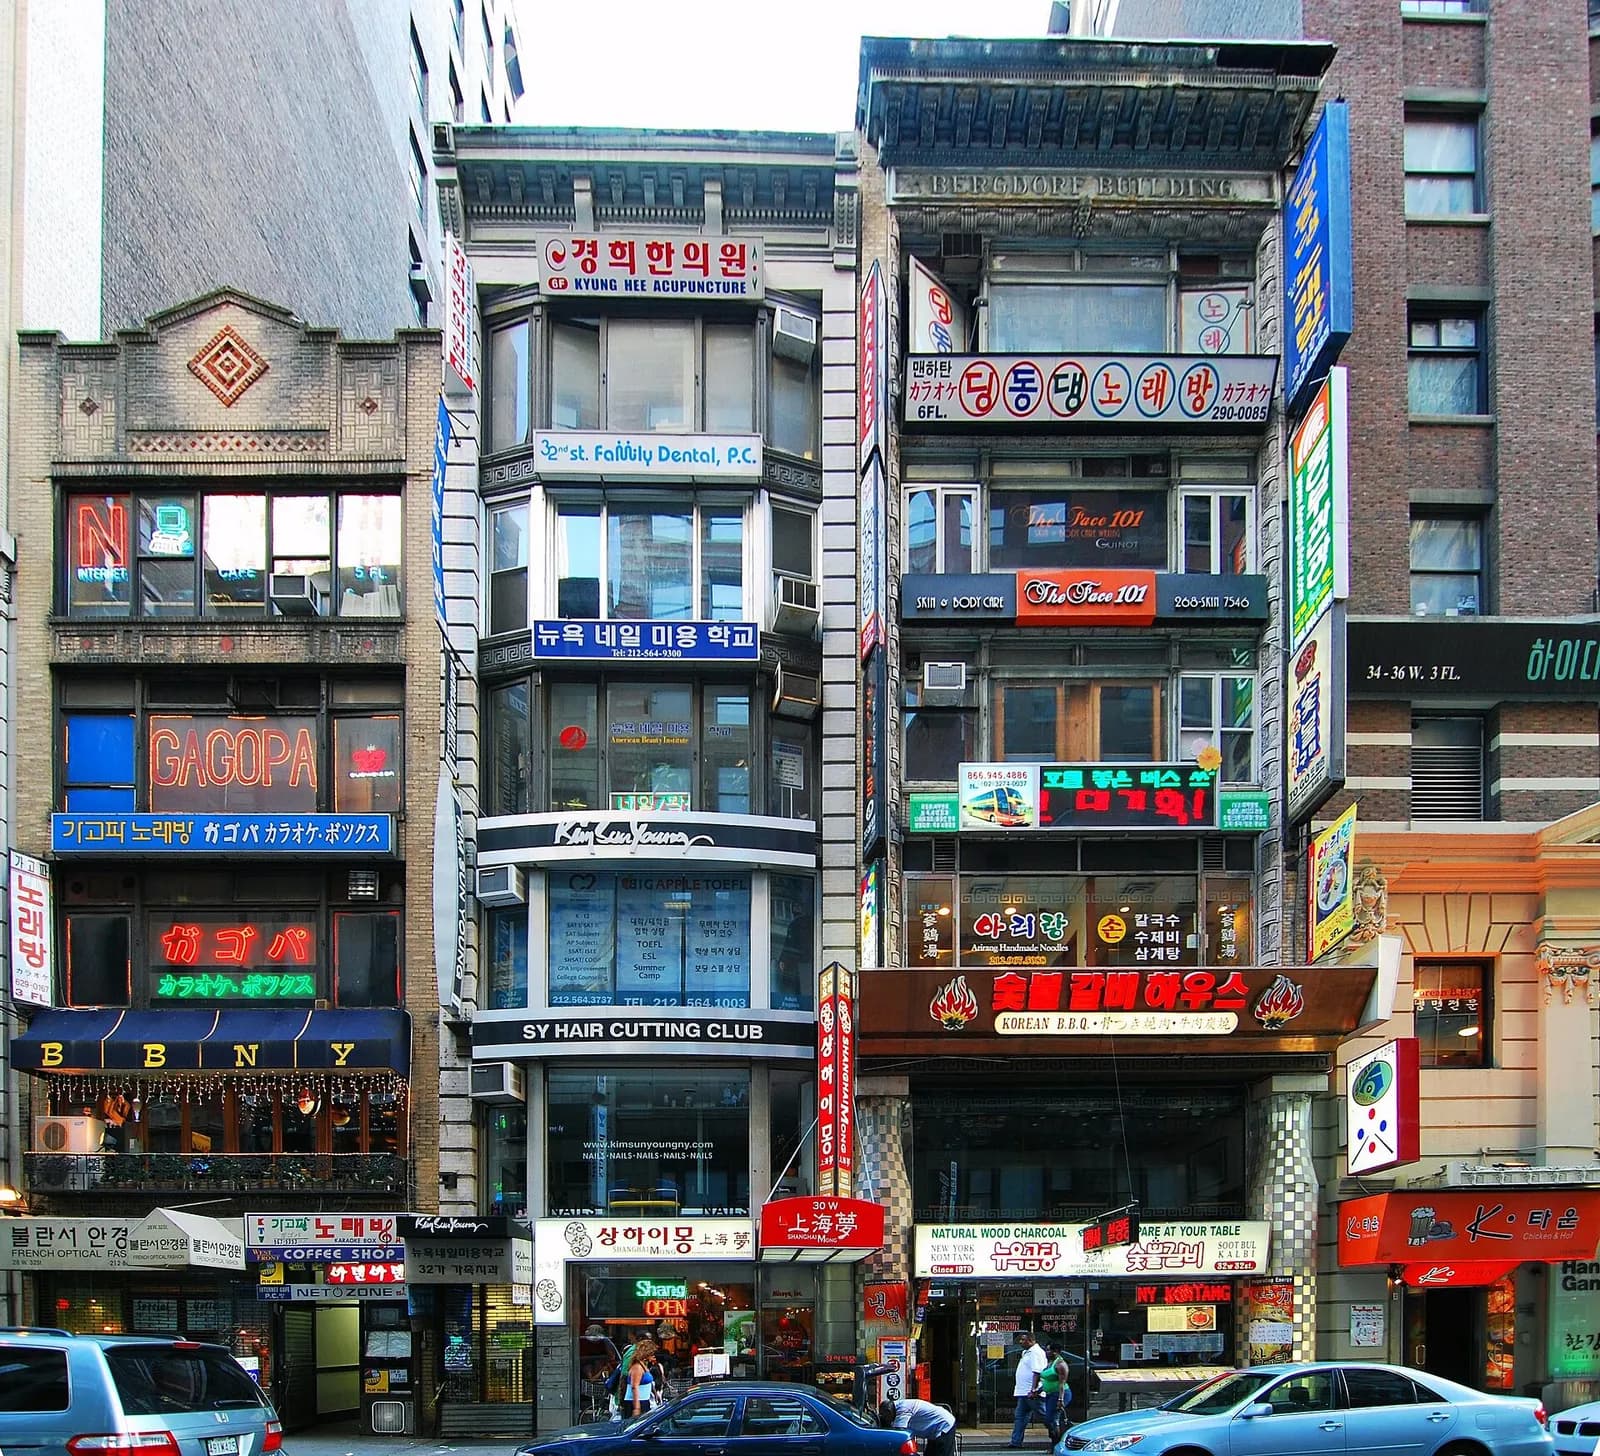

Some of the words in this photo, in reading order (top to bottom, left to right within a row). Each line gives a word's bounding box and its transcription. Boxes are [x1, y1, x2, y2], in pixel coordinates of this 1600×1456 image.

[933, 175, 1082, 196] BERGDORF
[1098, 176, 1236, 198] BUILDING
[571, 239, 746, 277] 경희한의원
[551, 278, 566, 289] 6F
[574, 278, 618, 292] KYUNG
[624, 279, 647, 292] HEE
[653, 280, 746, 294] ACUPUNCTURE
[911, 360, 953, 379] 맨하탄
[909, 380, 958, 401] カラオケ
[1098, 366, 1213, 413] 노래방
[1222, 382, 1271, 401] カラオケ
[917, 407, 948, 420] 6FL.
[1211, 405, 1267, 421] 290-0085
[570, 447, 589, 461] st.
[594, 440, 653, 467] Family
[658, 445, 721, 467] Dental,
[727, 447, 757, 465] P.C.
[1109, 510, 1145, 528] 101
[77, 566, 129, 582] INTERNET
[217, 567, 258, 581] CAFE
[1024, 579, 1066, 604] The
[1066, 579, 1114, 605] Face
[1114, 583, 1149, 605] 101
[916, 596, 936, 609] SKIN
[953, 596, 982, 609] BODY
[982, 596, 1005, 609] CARE
[1174, 596, 1220, 608] 268-SKIN
[1223, 596, 1250, 609] 7546
[537, 623, 584, 647] 뉴욕
[594, 623, 641, 647] 네일
[651, 624, 698, 648] 미용
[707, 625, 755, 648] 학교
[611, 648, 627, 658] Tel:
[626, 648, 682, 658] 212-564-9300
[1408, 665, 1425, 680] W.
[1429, 665, 1439, 680] 3
[1440, 665, 1461, 680] FL.
[150, 726, 318, 789] GAGOPA
[967, 771, 1028, 780] 866.945.4886
[62, 820, 126, 841] 가고파
[131, 820, 194, 845] 노래방
[204, 821, 260, 841] ガゴパ
[15, 855, 49, 877] 가고파
[705, 880, 749, 891] TOEFL
[973, 911, 1069, 941] 아리랑
[1134, 912, 1181, 926] 칼국수
[1101, 918, 1124, 940] 손
[163, 924, 310, 964] ガゴパ
[636, 940, 663, 949] TOEFL
[1134, 931, 1181, 945] 수제비
[642, 952, 657, 960] ESL
[971, 943, 999, 953] Arirang
[999, 943, 1039, 953] Handmade
[1040, 943, 1069, 953] Noodles
[1134, 946, 1181, 961] 삼계탕
[633, 963, 666, 972] Summer
[638, 972, 661, 981] Camp
[15, 987, 24, 998] 3
[31, 991, 50, 1004] FL.
[992, 971, 1063, 1011] 숯불
[1069, 971, 1138, 1011] 갈비
[1144, 971, 1249, 1011] 하우스
[551, 996, 613, 1005] 212.564.3737
[686, 998, 747, 1008] 564.1003
[522, 1023, 550, 1040] SY
[554, 1022, 604, 1039] HAIR
[609, 1021, 701, 1038] CUTTING
[706, 1022, 764, 1040] CLUB
[1002, 1017, 1050, 1030] KOREAN
[1056, 1017, 1091, 1030] B.B.Q.
[583, 1140, 714, 1151] www.kimsunyoungny.com
[812, 1201, 826, 1211] 30
[827, 1201, 839, 1210] W
[787, 1211, 859, 1240] 上海夢
[1526, 1207, 1581, 1231] 타운
[11, 1226, 77, 1248] 불란서
[596, 1226, 696, 1254] 상하이몽
[931, 1227, 978, 1239] NATURAL
[980, 1227, 1011, 1238] WOOD
[1013, 1226, 1068, 1238] CHARCOAL
[1163, 1225, 1175, 1237] AT
[1179, 1225, 1208, 1237] YOUR
[1210, 1225, 1241, 1236] TABLE
[1522, 1232, 1552, 1241] Chicken
[1552, 1232, 1560, 1240] &
[699, 1231, 752, 1251] 上海夢
[931, 1244, 950, 1253] NEW
[952, 1244, 975, 1253] YORK
[1217, 1240, 1240, 1250] SOOT
[1239, 1240, 1257, 1250] BUL
[11, 1249, 55, 1258] FRENCH
[57, 1249, 103, 1258] OPTICAL
[251, 1248, 273, 1256] WEST
[283, 1248, 343, 1260] COFFEE
[351, 1248, 396, 1260] SHOP
[930, 1253, 951, 1263] KOM
[952, 1253, 975, 1262] TANG
[990, 1241, 1062, 1272] 뉴욕곰탕
[1126, 1236, 1205, 1273] 숯불갈비
[931, 1265, 955, 1275] Since
[955, 1265, 973, 1274] 1979
[345, 1287, 393, 1298] ZONE
[635, 1279, 687, 1299] Shang
[1137, 1284, 1158, 1304] NY
[645, 1299, 687, 1316] OPEN
